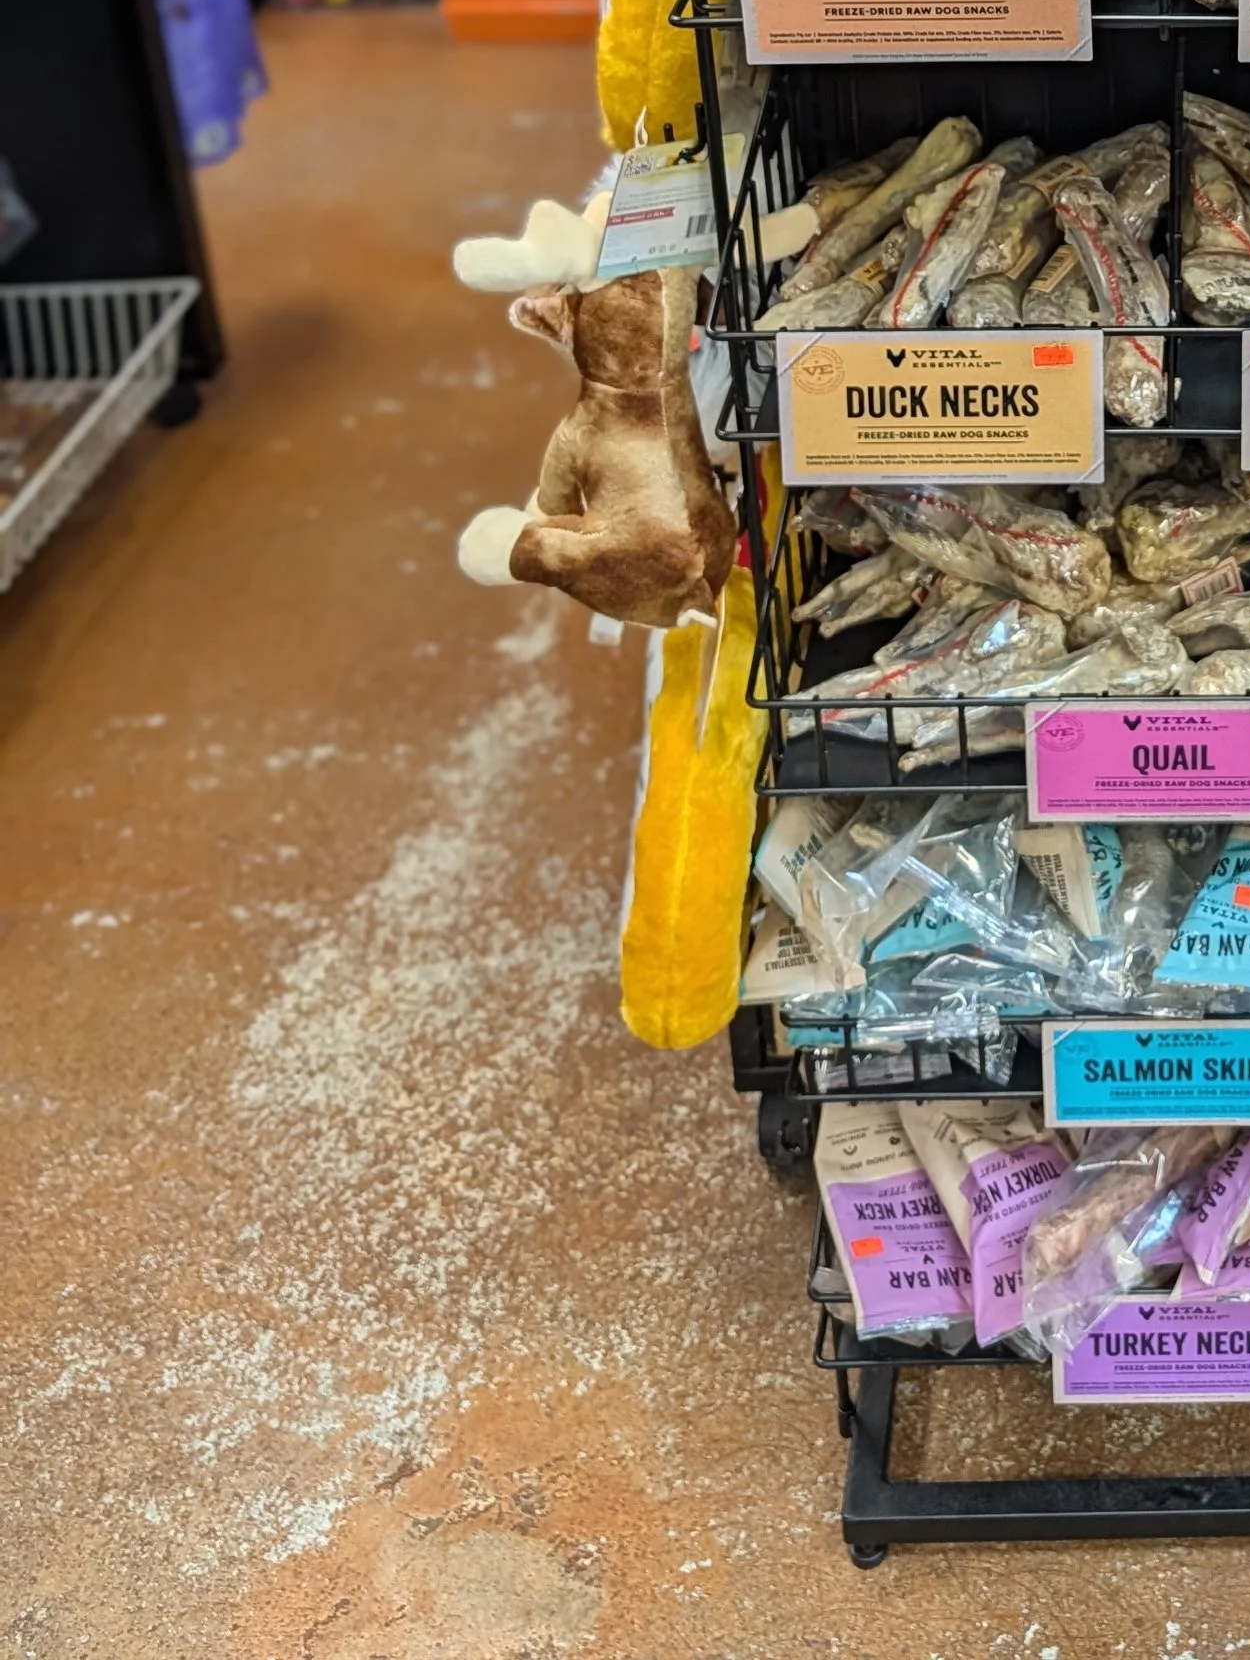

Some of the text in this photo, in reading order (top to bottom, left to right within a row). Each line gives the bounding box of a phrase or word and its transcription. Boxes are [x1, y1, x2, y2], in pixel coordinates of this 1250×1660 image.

[824, 6, 1010, 16] FREEZE-DRIED RAW DOG SNACKS
[911, 349, 982, 359] VITAL
[846, 384, 1040, 418] DUCK NECKS
[857, 429, 1029, 439] FREEZE-DRIED RAW DOG SNACKS
[1146, 716, 1212, 724] VITAL
[1132, 744, 1215, 775] QUAIL
[1198, 904, 1249, 924] VITAL
[1083, 1057, 1193, 1083] SALMON
[1219, 1146, 1243, 1179] AW
[853, 1201, 895, 1221] NECK
[888, 1270, 930, 1289] BAR
[1088, 1331, 1189, 1357] TURKEY
